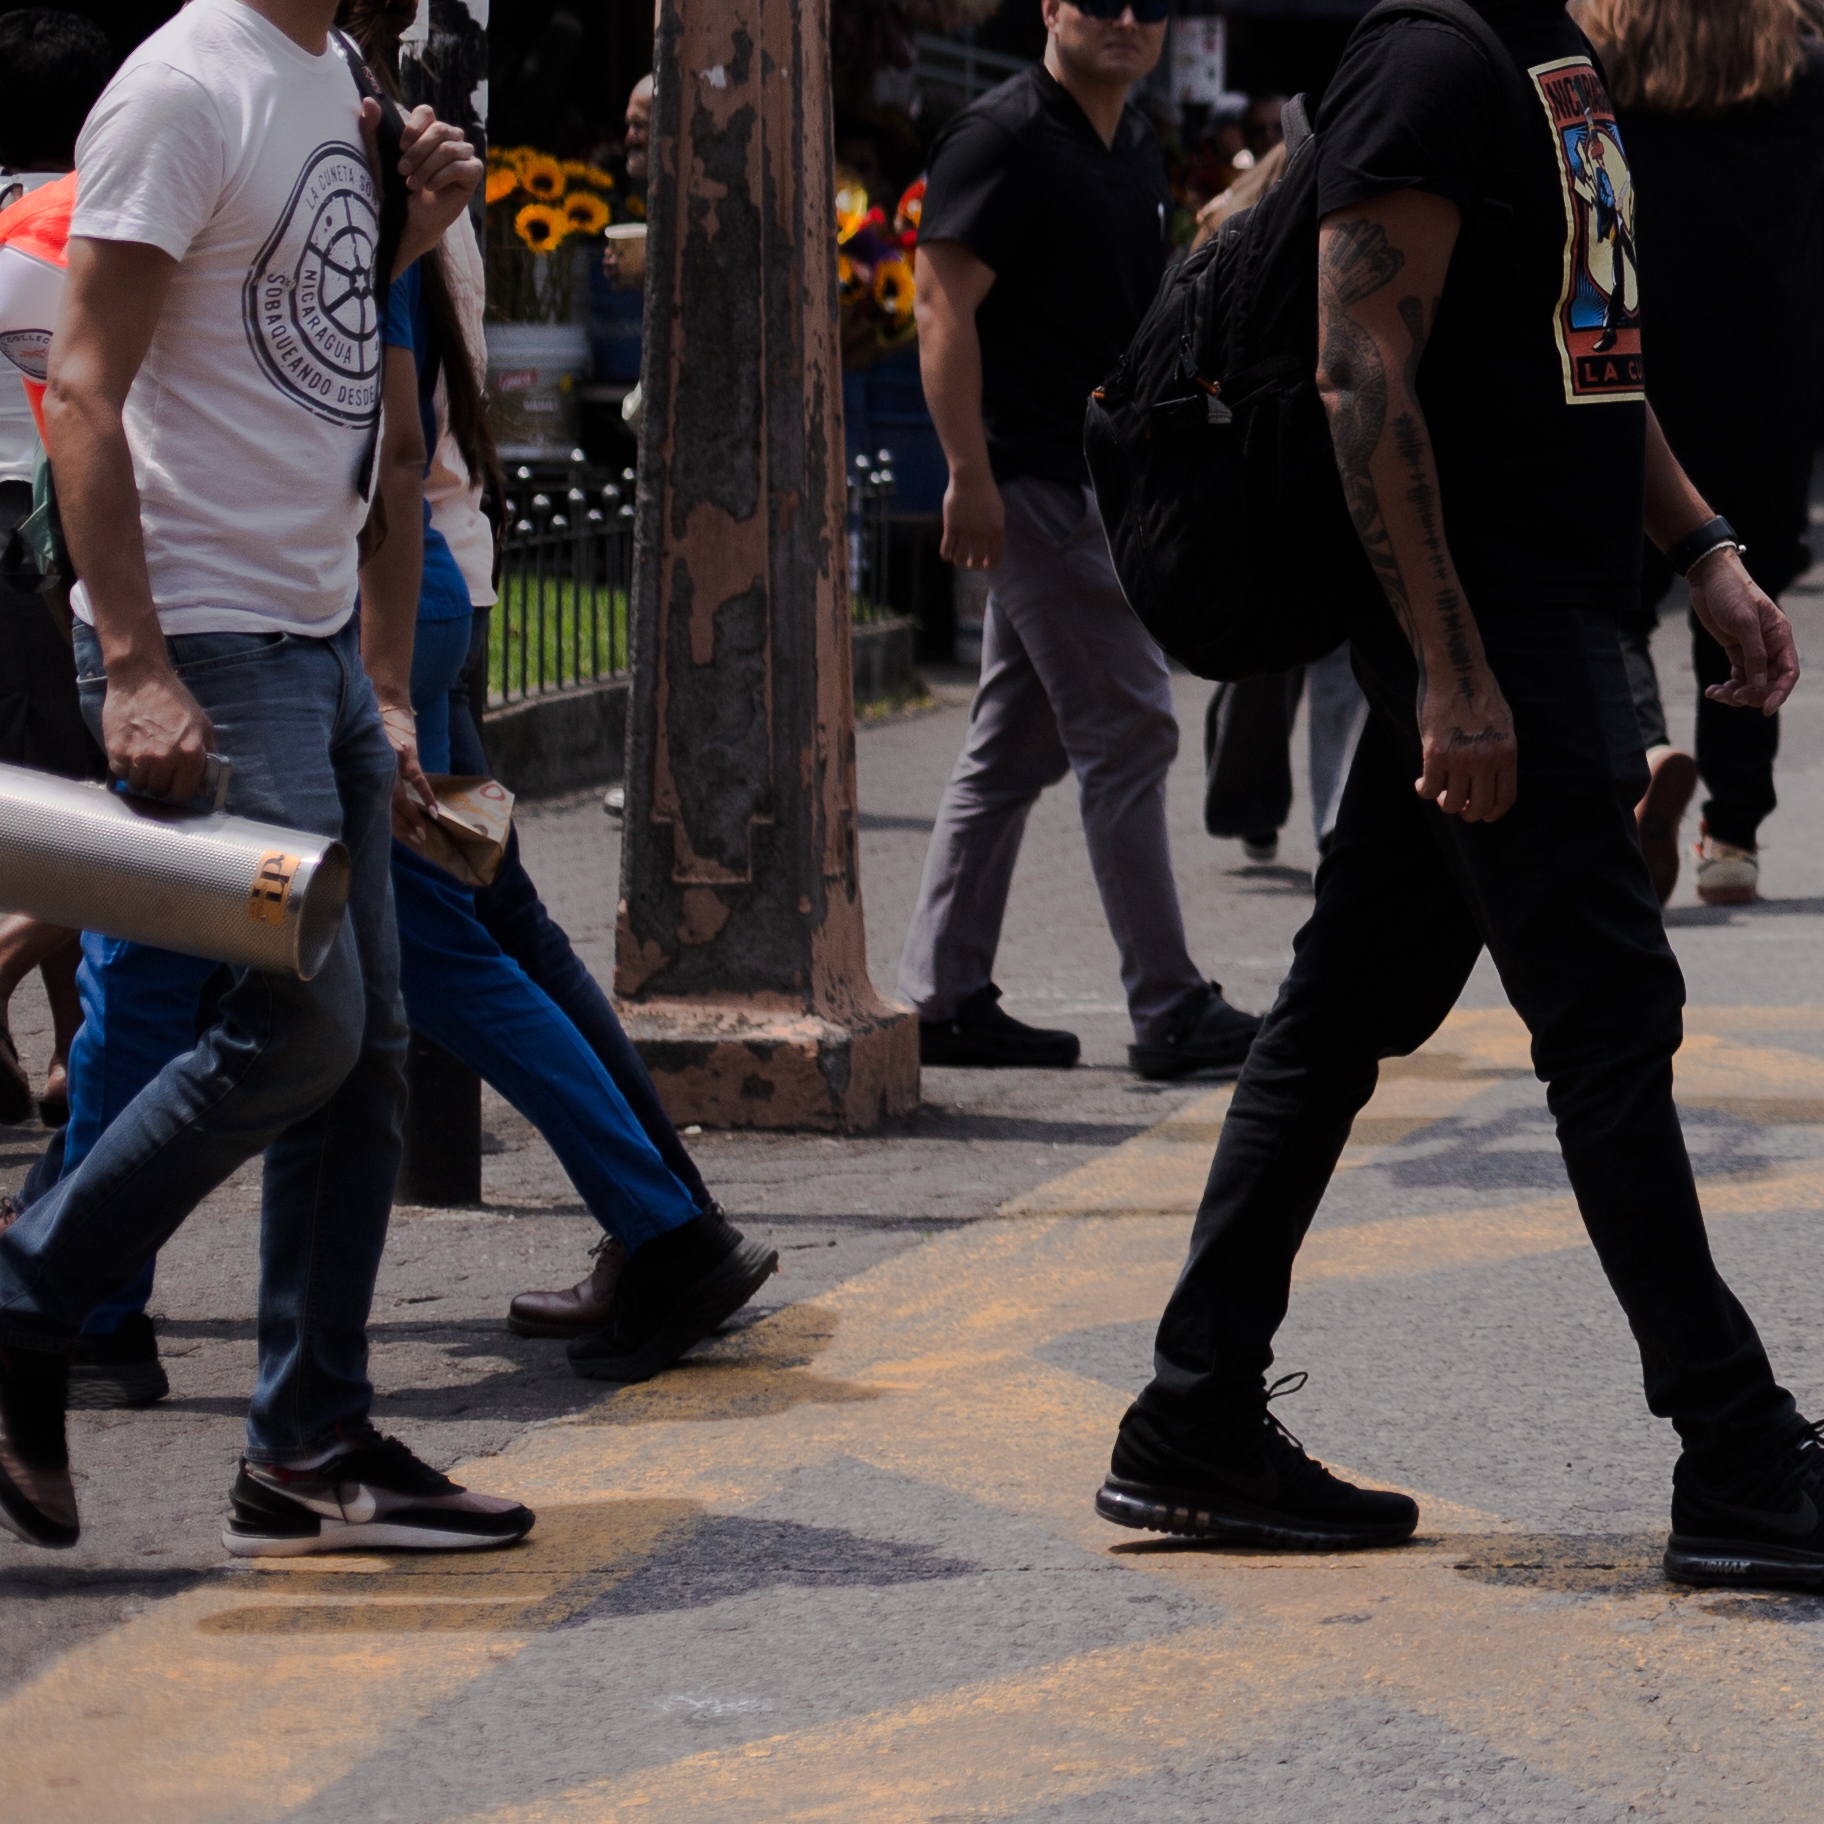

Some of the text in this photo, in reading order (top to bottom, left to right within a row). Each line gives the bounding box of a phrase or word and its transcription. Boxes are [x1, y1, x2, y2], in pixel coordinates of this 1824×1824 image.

[306, 186, 319, 210] LA
[318, 164, 354, 191] CUNETA
[264, 273, 332, 396] SOBAQUEANDO
[301, 269, 352, 364] NICARAGUA
[1584, 361, 1620, 383] LA
